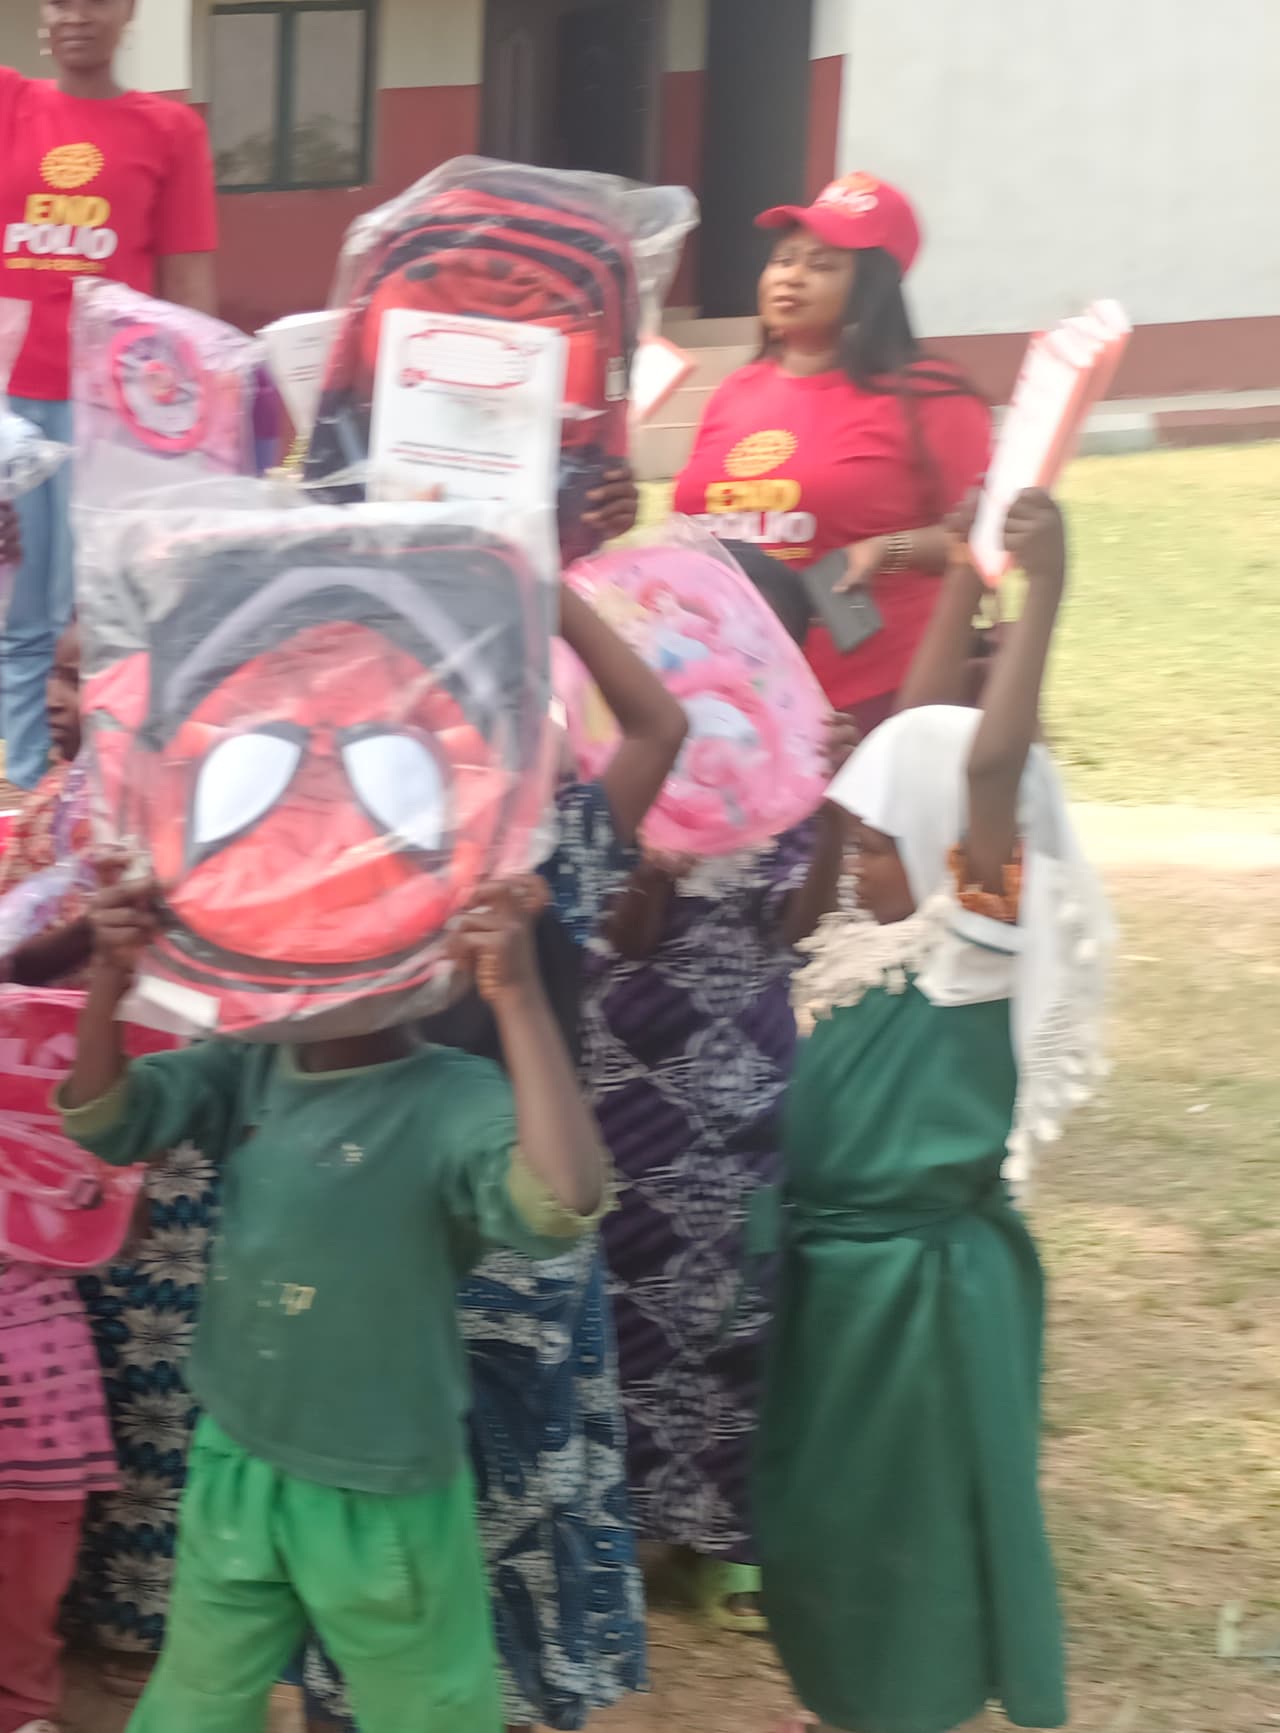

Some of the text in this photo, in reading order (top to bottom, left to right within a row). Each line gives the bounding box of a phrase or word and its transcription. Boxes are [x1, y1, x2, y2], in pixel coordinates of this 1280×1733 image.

[24, 193, 111, 229] END
[2, 222, 119, 260] POLIO
[704, 479, 802, 514] END
